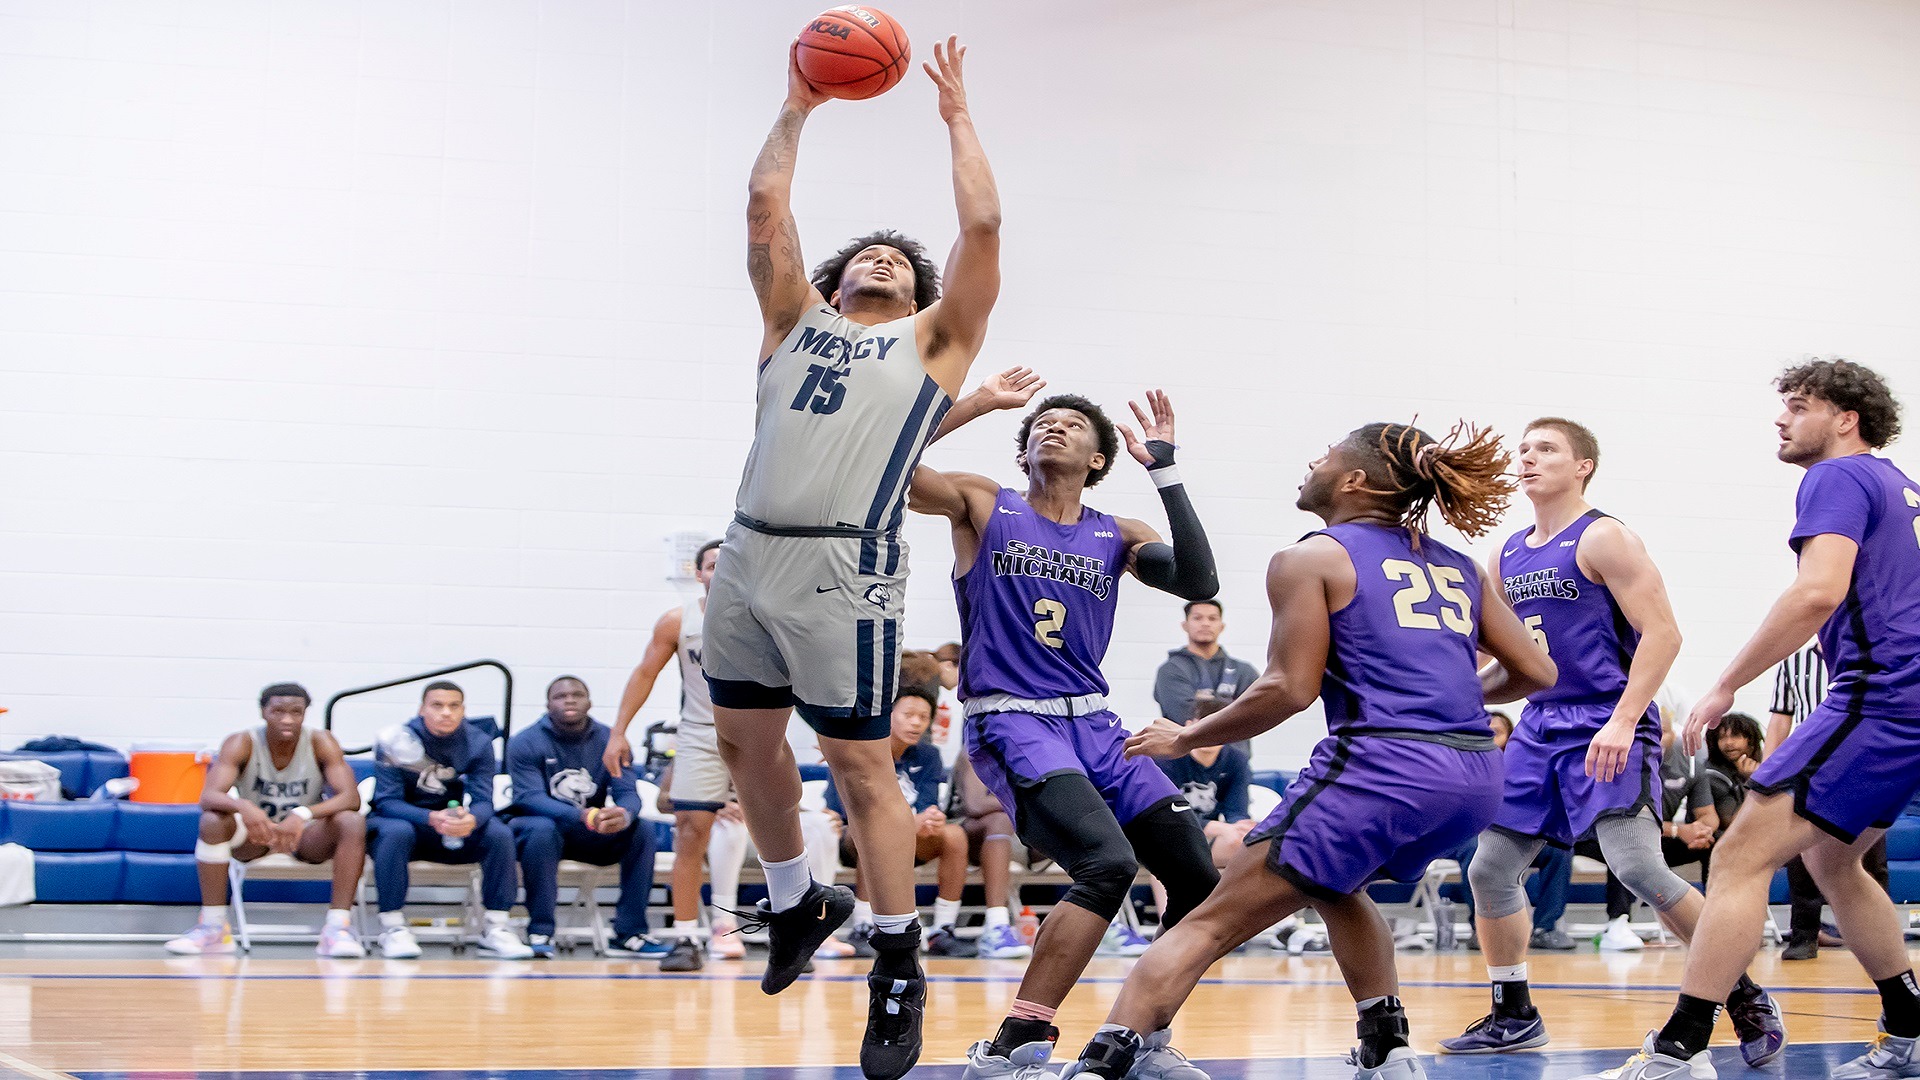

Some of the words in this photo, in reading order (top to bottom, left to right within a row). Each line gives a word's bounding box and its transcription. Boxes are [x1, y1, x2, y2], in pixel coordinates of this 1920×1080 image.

[806, 20, 852, 40] NCAA
[790, 326, 900, 365] MERCY
[789, 363, 851, 415] 15
[1006, 540, 1105, 573] SAINT
[1504, 567, 1559, 590] SAINT
[1381, 558, 1474, 637] 25
[1033, 598, 1067, 649] 2
[253, 776, 310, 798] MERCY
